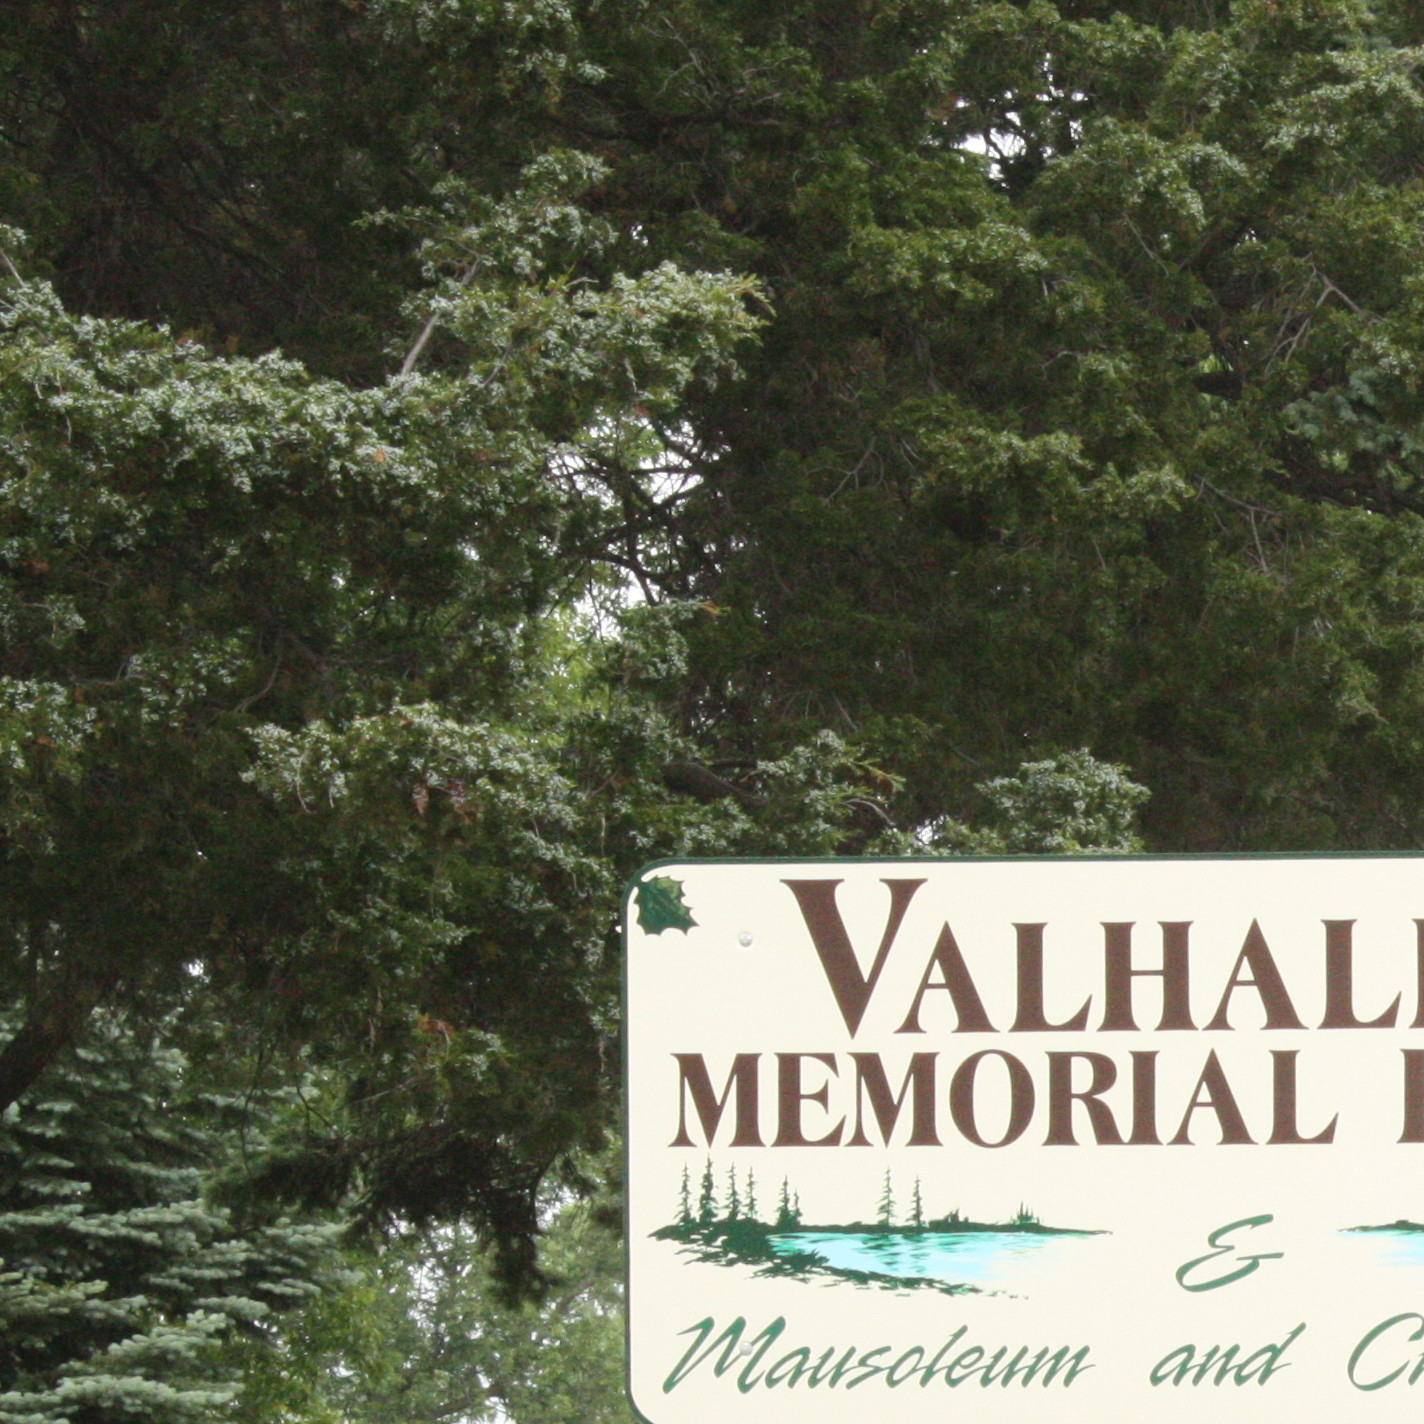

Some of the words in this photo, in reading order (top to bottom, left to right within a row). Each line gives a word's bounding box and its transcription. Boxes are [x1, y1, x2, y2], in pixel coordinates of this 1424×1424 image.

[668, 1047, 1338, 1149] MEMORIAL
[1175, 1213, 1284, 1293] &
[662, 1315, 1094, 1395] Mausoleum
[1148, 1321, 1306, 1388] and
